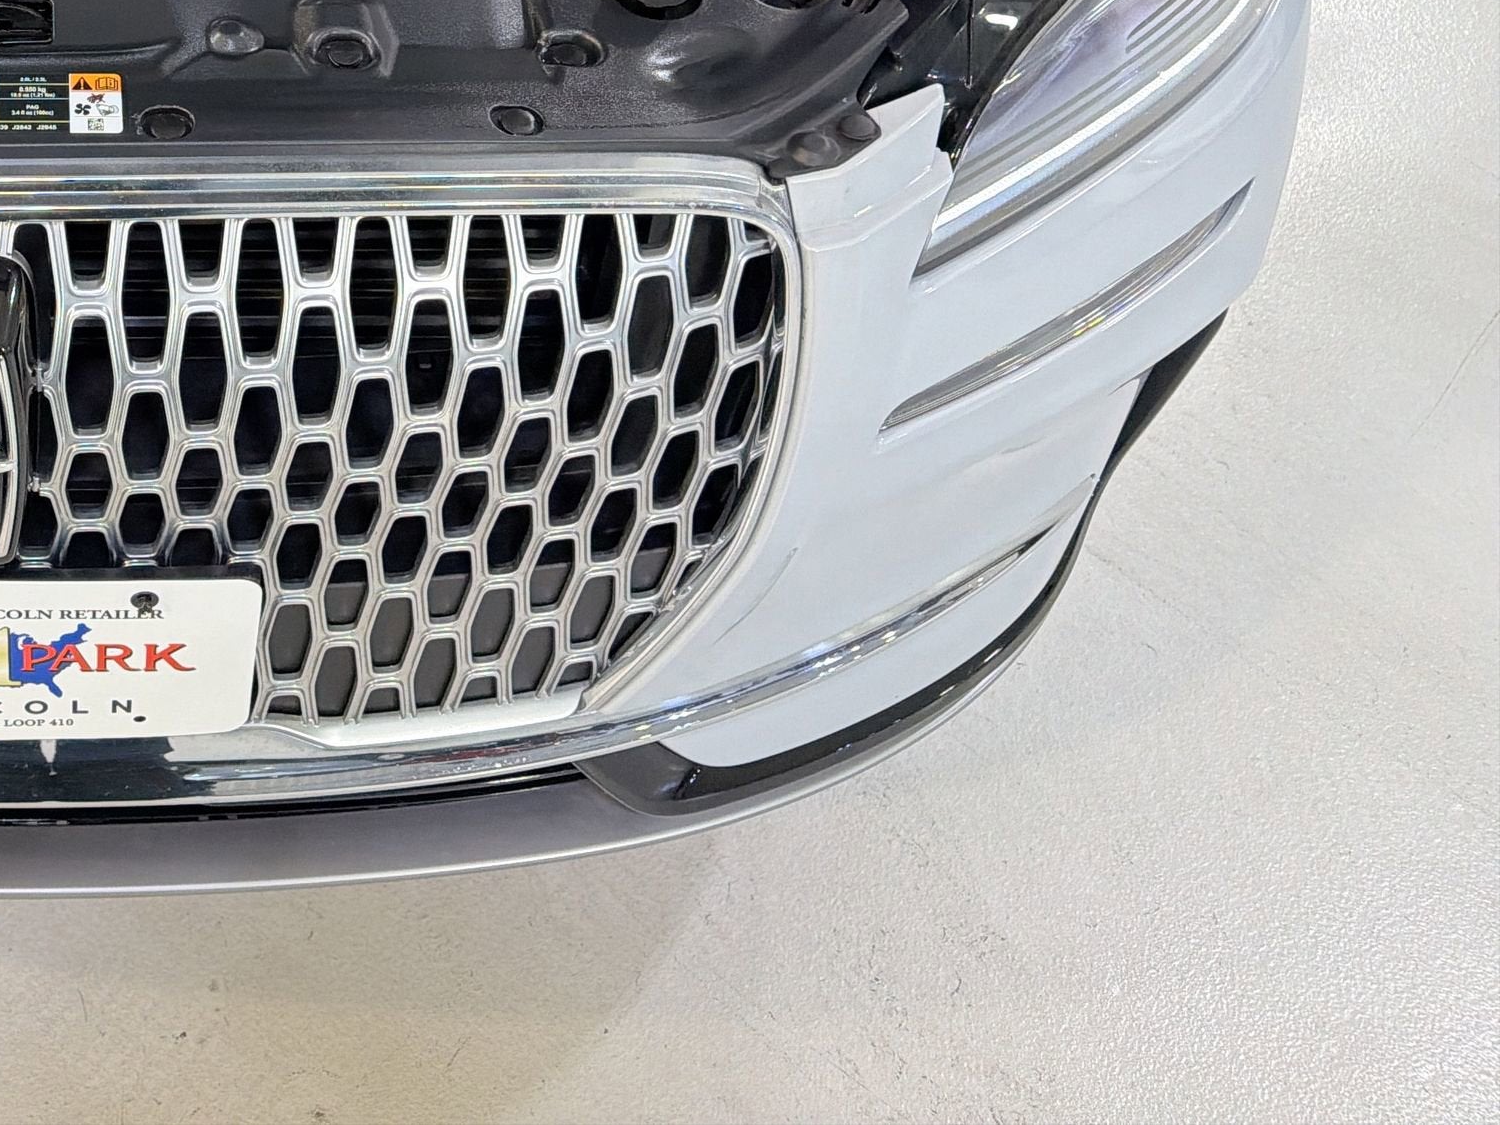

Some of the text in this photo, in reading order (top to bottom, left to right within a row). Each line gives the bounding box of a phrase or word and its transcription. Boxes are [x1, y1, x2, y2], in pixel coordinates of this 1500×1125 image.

[37, 86, 47, 94] kg
[59, 609, 165, 620] RETAILER
[20, 642, 197, 673] PARK
[3, 718, 46, 728] LOOP
[49, 718, 75, 727] 410
